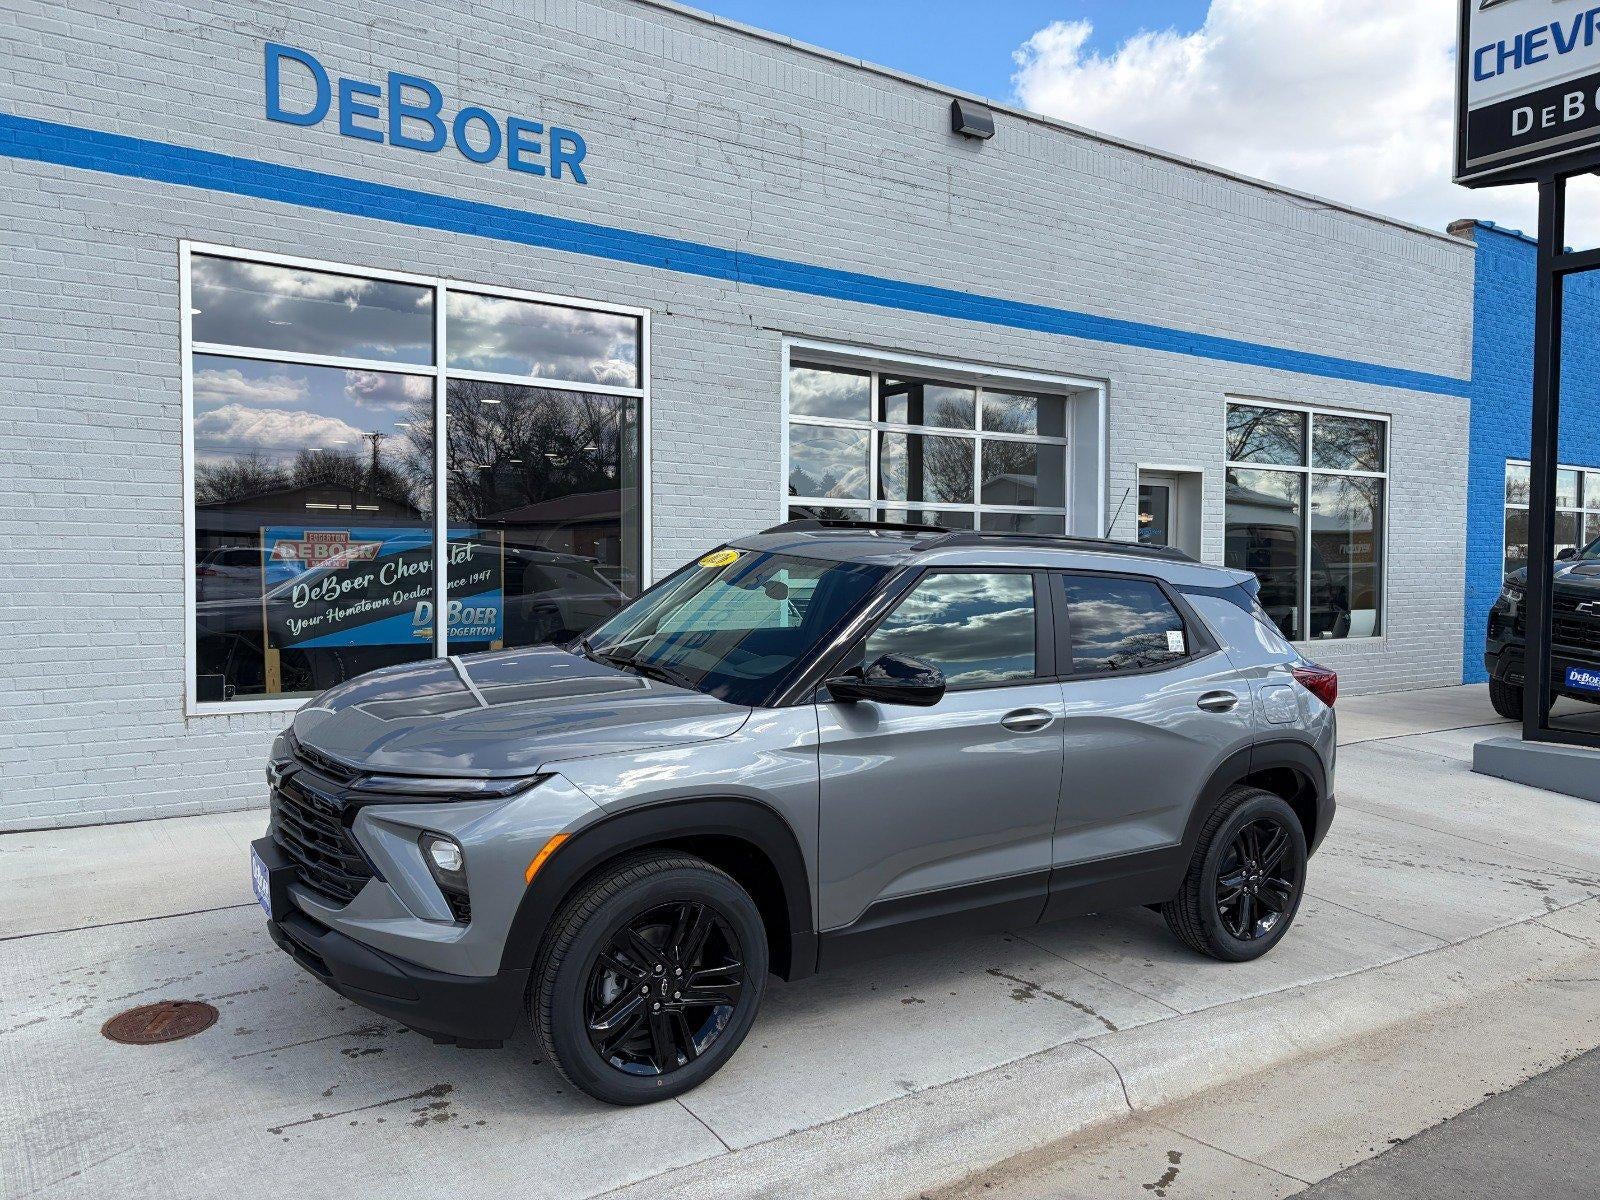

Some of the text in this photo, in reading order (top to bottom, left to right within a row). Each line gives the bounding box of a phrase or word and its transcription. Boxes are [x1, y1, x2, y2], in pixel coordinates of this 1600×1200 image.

[1511, 85, 1600, 137] DEB
[279, 543, 375, 559] DEBOER
[309, 533, 346, 542] EDGERTON
[292, 541, 481, 609] DeBoer Chevlet
[286, 569, 492, 636] Your Hometown Dealer nce 1947
[412, 600, 497, 626] DBOER
